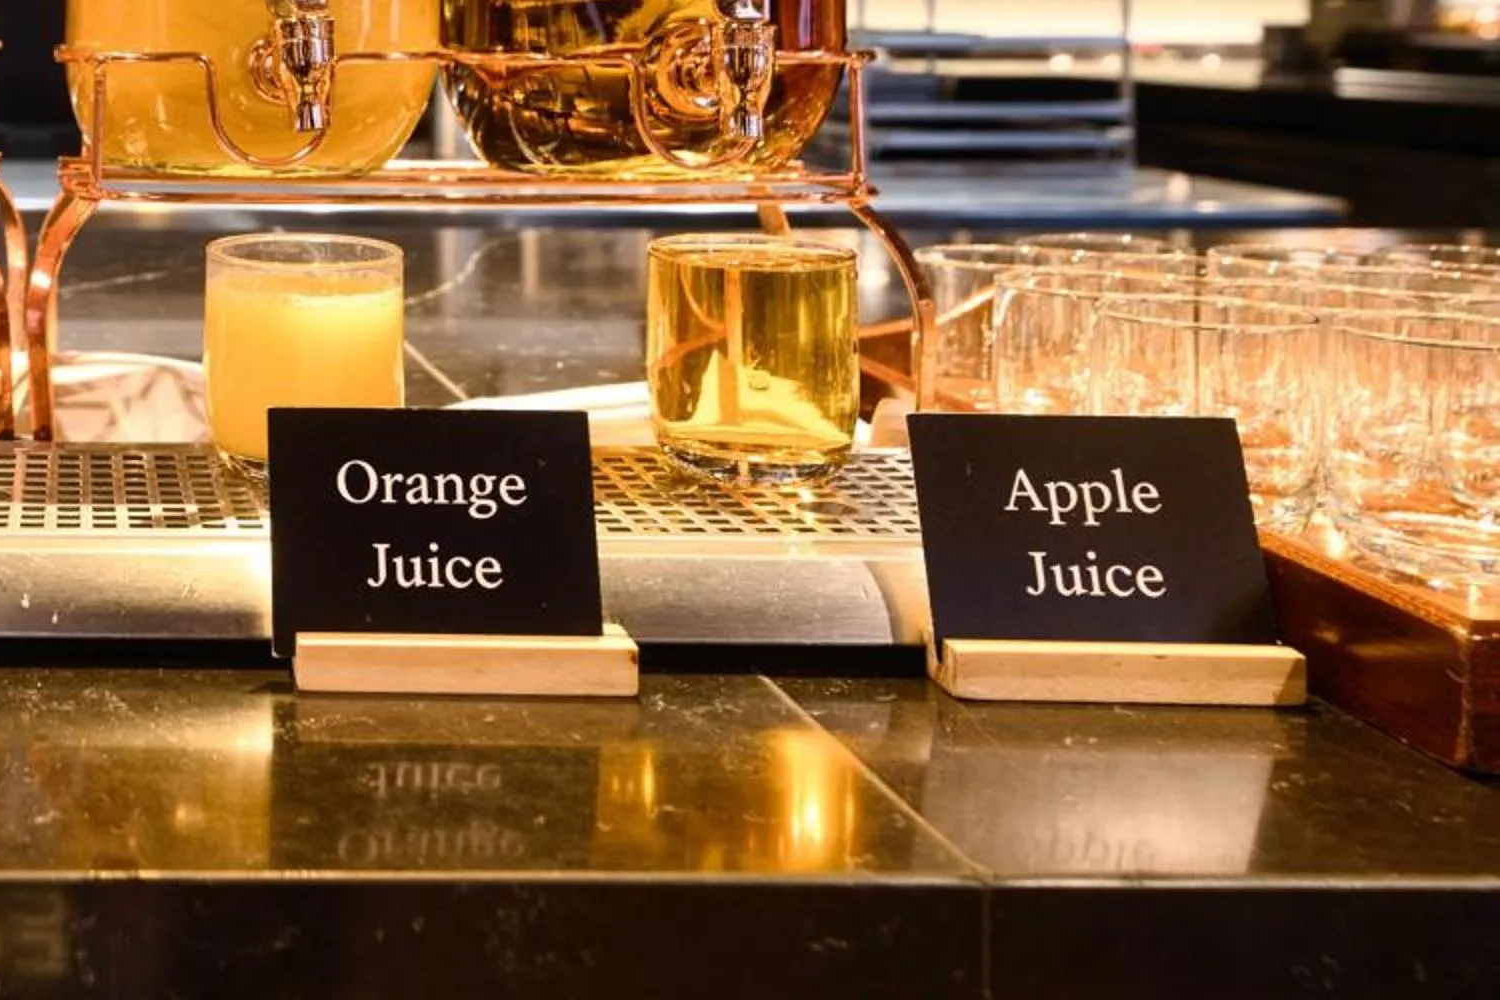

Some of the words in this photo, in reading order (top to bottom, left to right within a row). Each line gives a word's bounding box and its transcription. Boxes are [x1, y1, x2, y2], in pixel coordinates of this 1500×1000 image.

[337, 459, 527, 519] Orange
[1004, 467, 1162, 527] Apple
[367, 542, 503, 589] Juice
[1026, 550, 1167, 598] Juice
